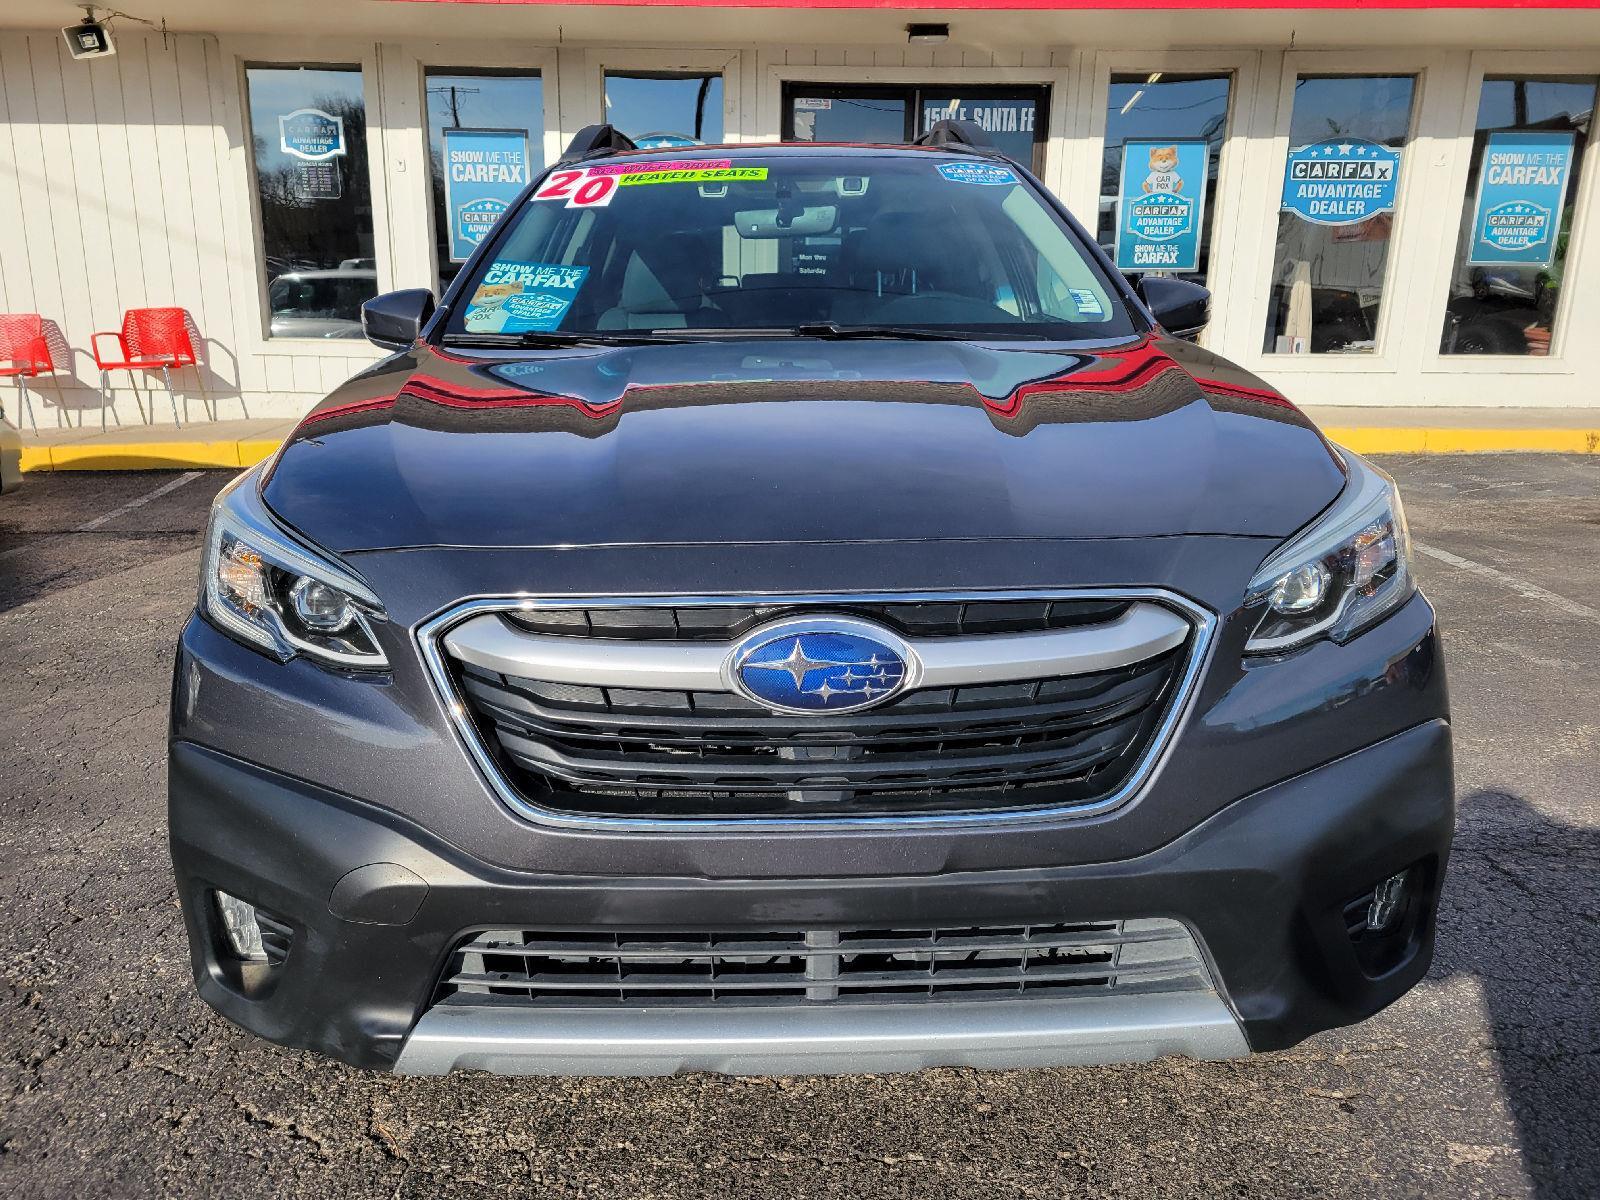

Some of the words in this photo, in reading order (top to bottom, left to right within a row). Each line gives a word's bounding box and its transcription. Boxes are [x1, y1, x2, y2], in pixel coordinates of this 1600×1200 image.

[973, 107, 1017, 132] SANTA
[1020, 107, 1035, 132] FE
[292, 137, 334, 145] ADVANTAGE
[300, 145, 328, 153] DEALER
[450, 150, 483, 163] SHOW
[485, 152, 500, 163] ME
[503, 152, 521, 163] THE
[1491, 152, 1525, 165] SHOW
[1526, 154, 1543, 165] ME
[1545, 153, 1564, 165] THE
[452, 163, 524, 183] CARFAX
[621, 170, 696, 183] HEATED
[701, 167, 762, 178] SEATS
[1294, 162, 1390, 180] CARFAX
[1488, 165, 1562, 185] CARFAX
[1156, 175, 1170, 183] CAR
[1296, 184, 1383, 199] ADVANTAGE
[1133, 206, 1188, 216] CARFAX
[1309, 200, 1366, 215] DEALER
[463, 213, 502, 224] CARF
[1136, 217, 1183, 226] ADVANTAGE
[1490, 215, 1545, 227] CARFAX
[1144, 226, 1175, 235] DEALER
[1491, 227, 1539, 237] ADVANTAGE
[1498, 236, 1529, 245] DEALER
[1134, 244, 1155, 253] SHOW
[1156, 244, 1167, 253] ME
[1134, 252, 1178, 264] CARFAX
[490, 262, 534, 273] SHOW
[535, 266, 557, 275] ME
[559, 267, 584, 278] THE
[483, 271, 582, 289] CARFAX
